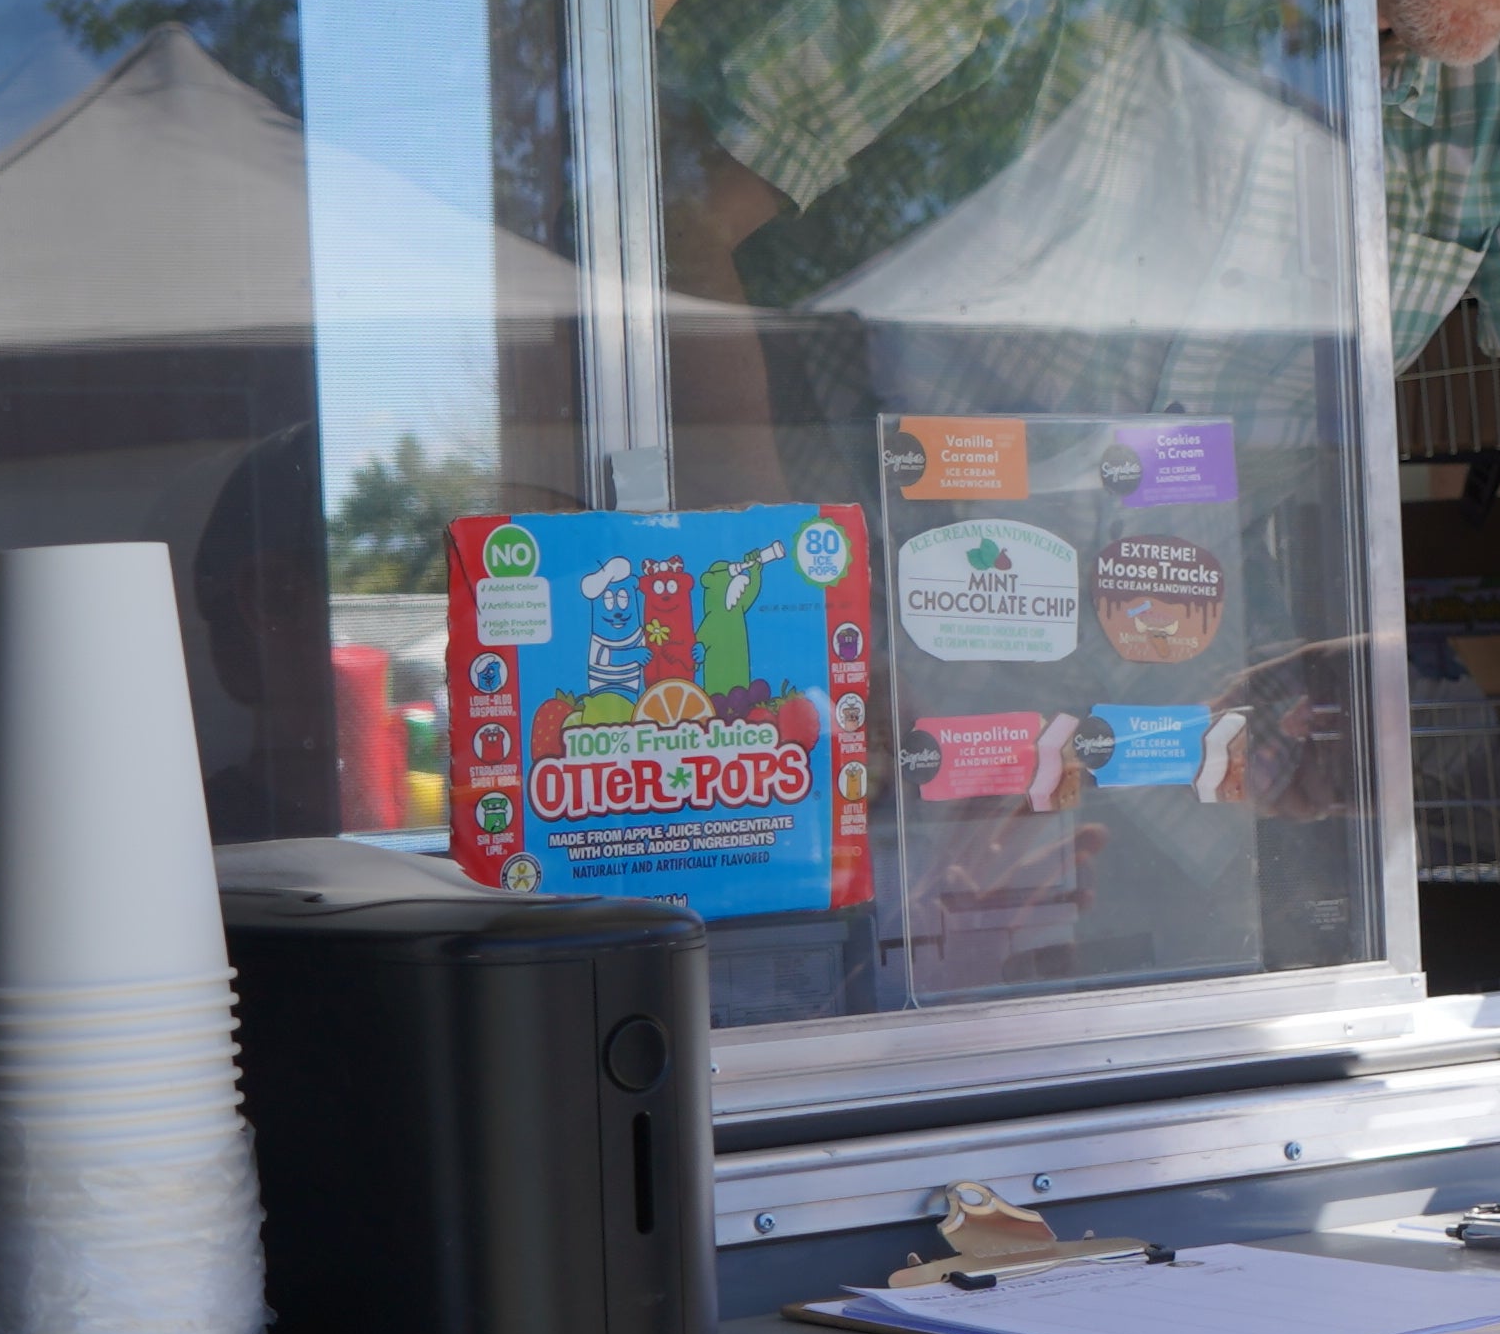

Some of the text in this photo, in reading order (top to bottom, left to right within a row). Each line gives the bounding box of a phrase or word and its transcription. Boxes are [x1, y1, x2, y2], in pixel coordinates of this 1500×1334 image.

[945, 435, 994, 448] Vanilla
[1157, 434, 1201, 446] Cookies
[940, 450, 999, 463] Caramel
[1168, 448, 1204, 459] Cream
[963, 467, 996, 476] CREAM
[940, 480, 1002, 489] SANDWICHES
[806, 529, 840, 554] 80
[909, 524, 1074, 563] ICE CREAM SANDWICHES
[491, 543, 532, 567] NO
[1121, 542, 1197, 562] EXTREME!
[813, 556, 833, 566] ICE
[808, 566, 839, 577] POPS
[1098, 557, 1219, 584] Moose Tracks
[488, 583, 538, 592] Added Color
[968, 573, 1019, 593] MINT
[1098, 579, 1218, 597] ICE CREAM SANDWICHES
[488, 601, 546, 610] Artificial Dyes
[908, 590, 1076, 617] CHOCOLATE CHIP
[489, 619, 547, 629] High Fructose
[1129, 716, 1182, 732] Vanilla
[568, 725, 774, 757] 100% Fruit Juice
[940, 727, 1029, 746] Neapolitan
[1131, 739, 1180, 748] ICE CREAM
[960, 746, 1012, 756] ICE CREAM
[1125, 748, 1186, 758] SANDWICHES
[954, 755, 1018, 767] SANDWICHES
[549, 816, 793, 847] MADE FROM APPLE JUICE CONCENTRATE
[569, 832, 775, 861] WITH OTHER ADDED INGREDIENTS
[573, 851, 769, 879] NATURALLY AND ARTIFICIALLY FLAVORED
